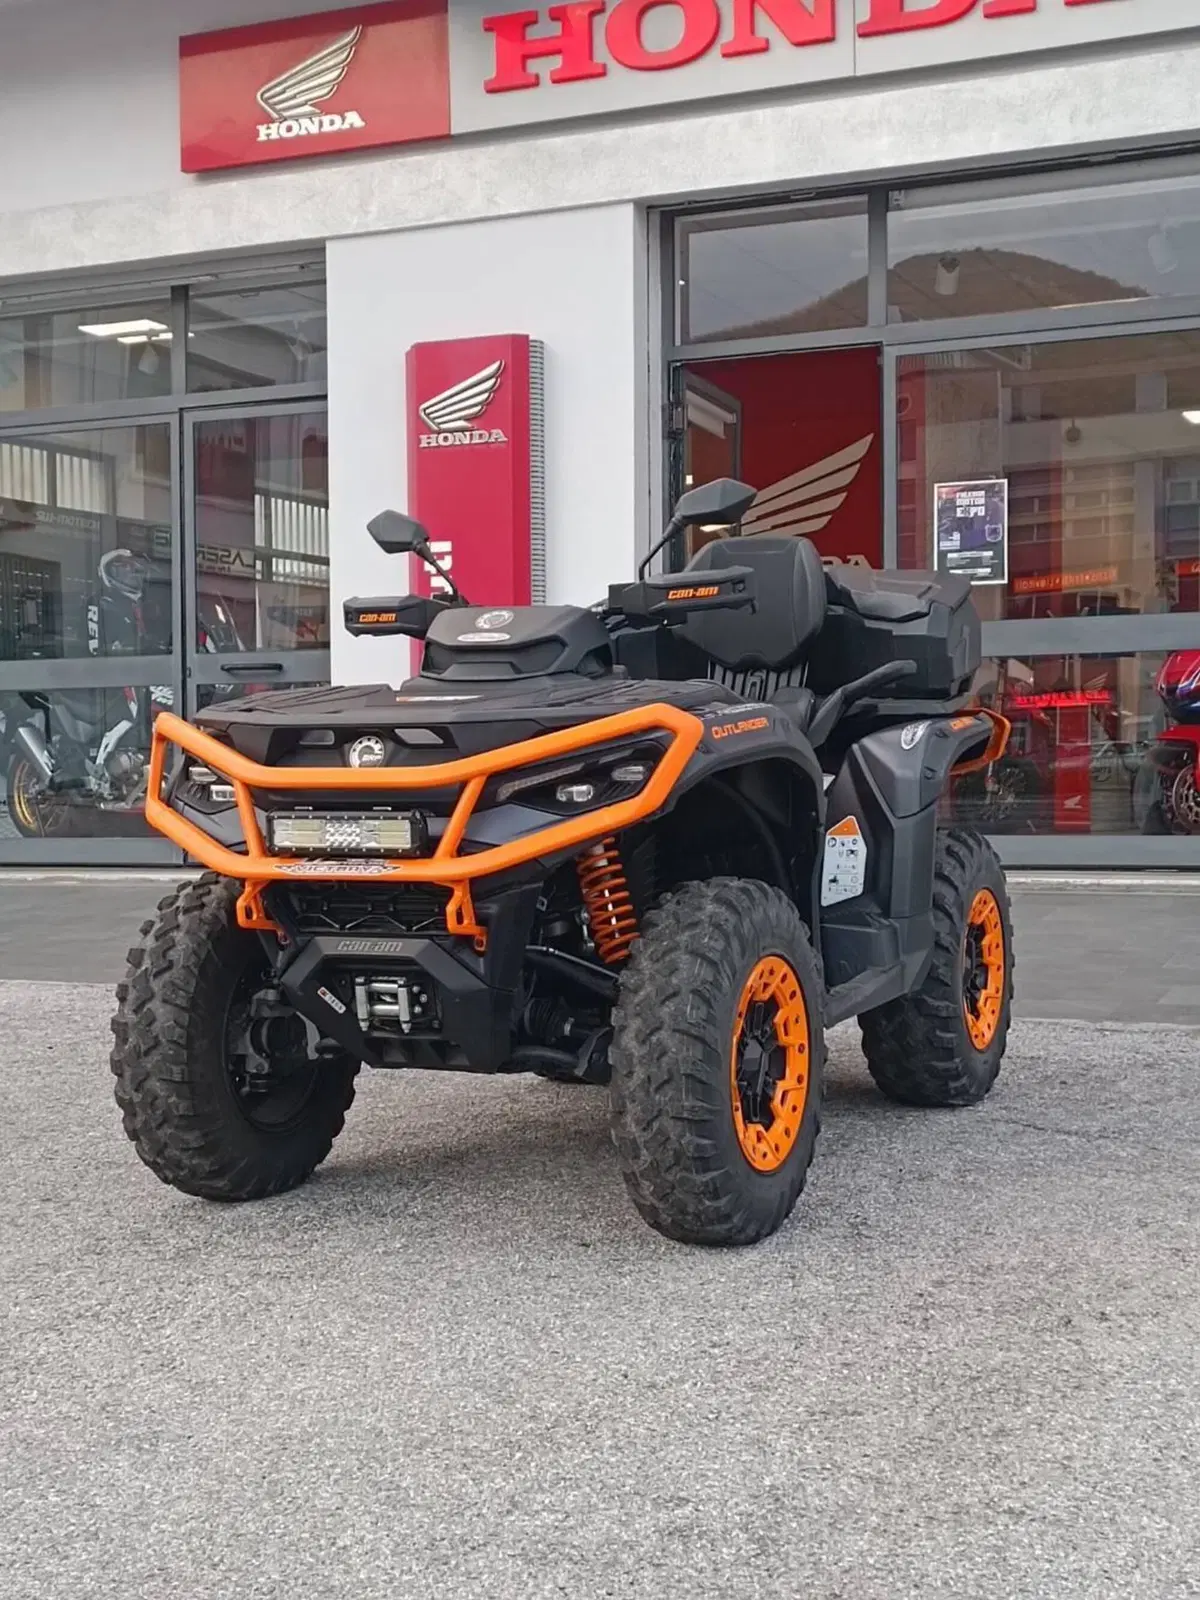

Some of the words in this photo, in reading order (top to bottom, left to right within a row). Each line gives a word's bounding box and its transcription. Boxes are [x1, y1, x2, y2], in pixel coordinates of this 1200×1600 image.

[483, 0, 1131, 93] HOND
[256, 111, 366, 141] HONDA
[419, 429, 508, 448] HONDA
[956, 506, 985, 518] EXPO
[668, 586, 719, 600] can-am
[359, 612, 396, 623] can-am
[337, 939, 403, 952] can-am
